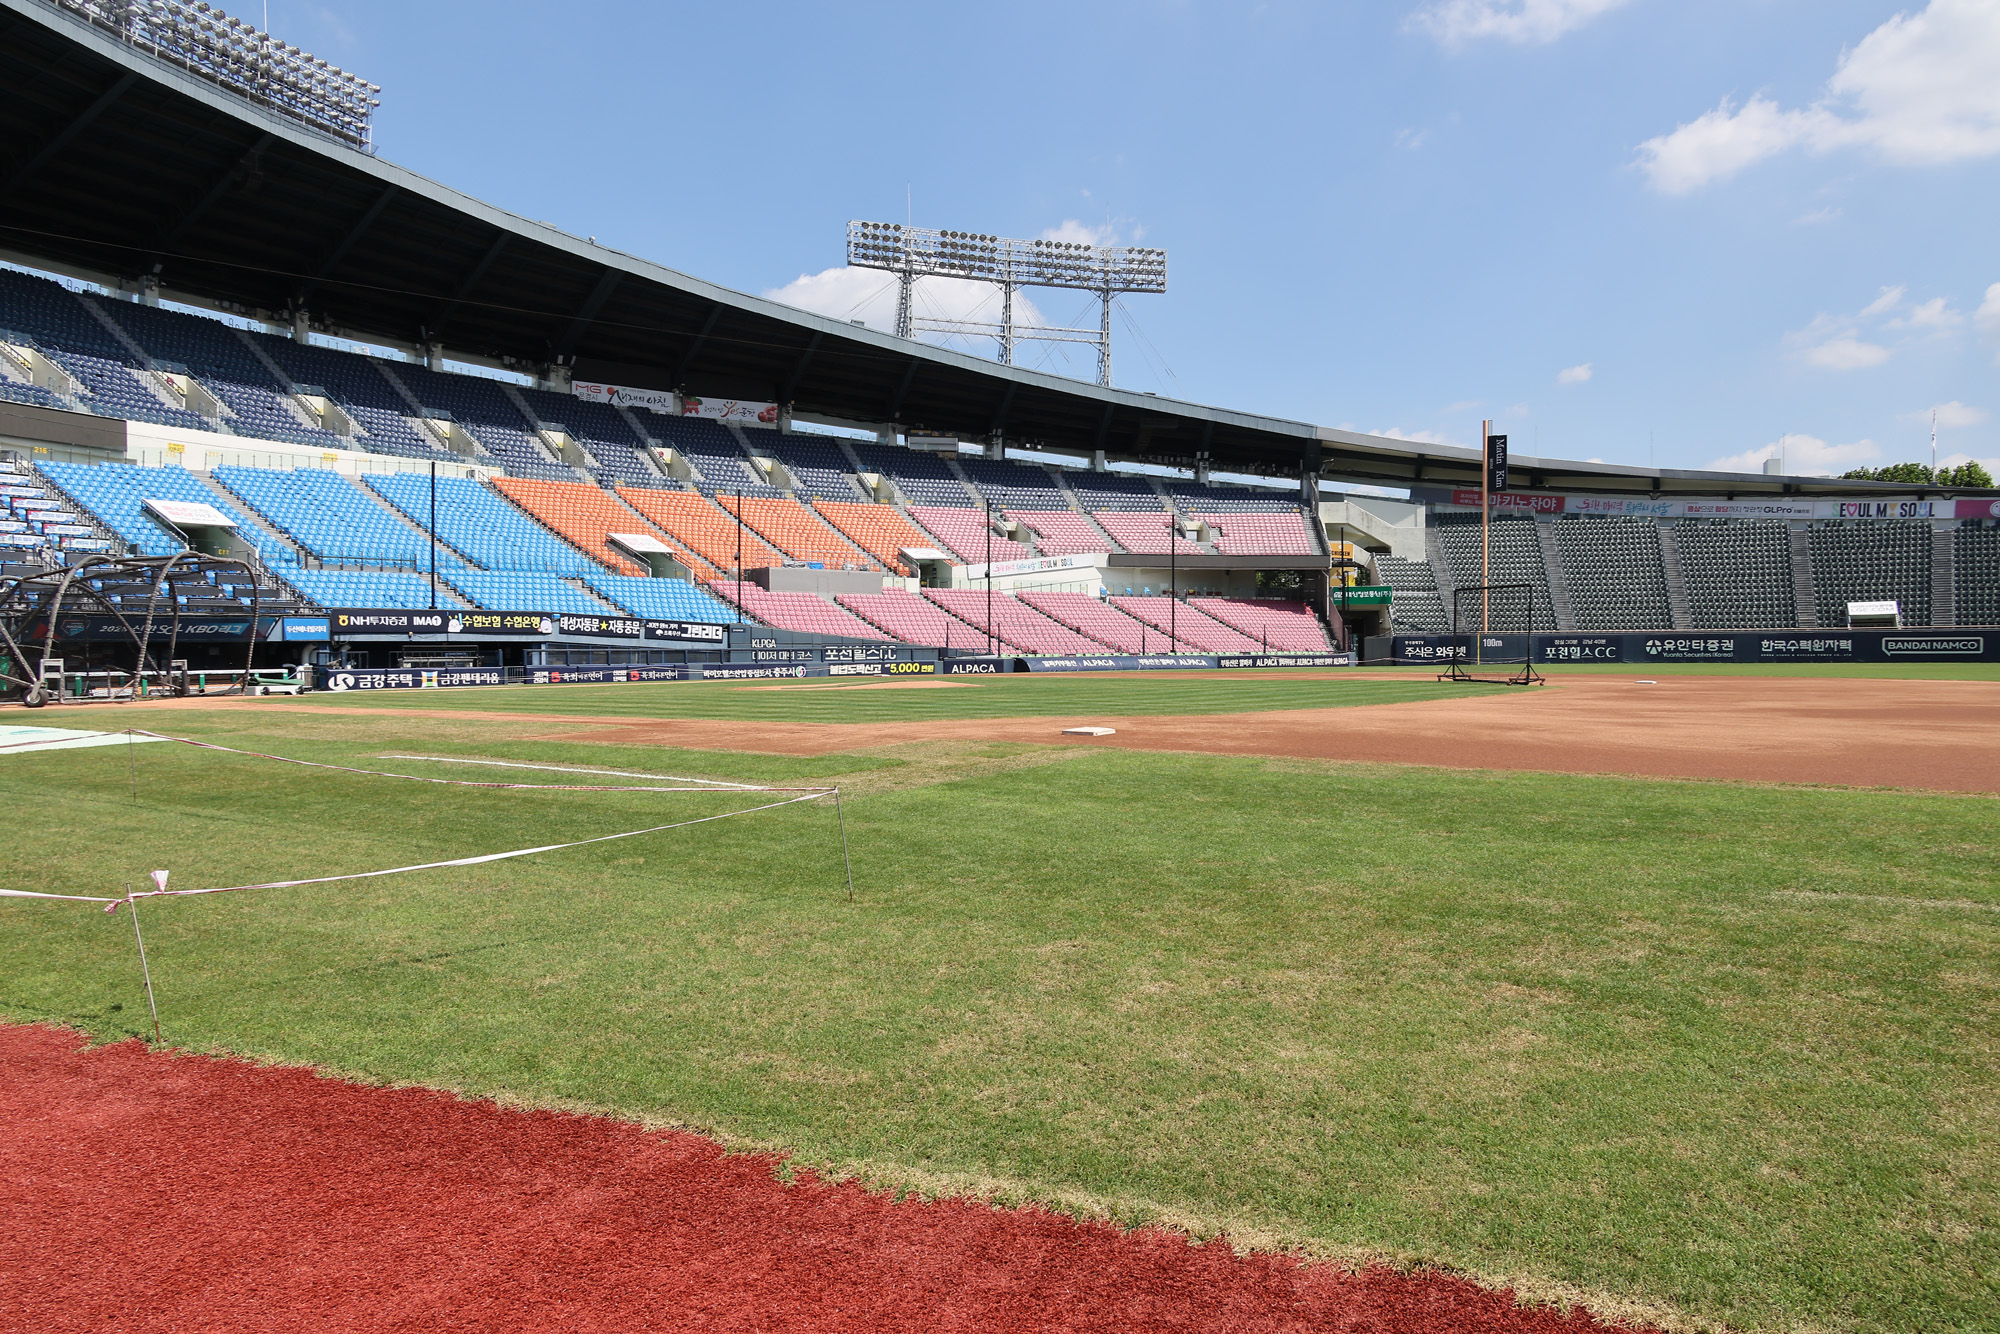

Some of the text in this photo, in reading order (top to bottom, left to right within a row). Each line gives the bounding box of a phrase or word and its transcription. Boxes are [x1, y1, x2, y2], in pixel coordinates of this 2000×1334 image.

[1495, 438, 1505, 489] Matin Kim
[1488, 493, 1557, 510] 마키노차야
[1650, 502, 1673, 516] 서울
[1763, 506, 1793, 514] GLPro
[350, 615, 408, 626] NH투자증권
[462, 615, 541, 629] 수협보험 수협은행
[559, 616, 640, 635] 태성자동문 자동중문
[286, 625, 327, 633] 두산에너빌리티
[681, 623, 723, 640] 그린리더
[751, 638, 777, 649] KLPGA
[1482, 638, 1503, 648] 100m
[1662, 639, 1734, 652] 유안타증권
[1760, 639, 1852, 652] 한국수력원자력
[1887, 641, 1978, 650] BANDAI NAMCO
[797, 651, 813, 660] 코스
[1404, 646, 1434, 658] 주식은
[1544, 646, 1616, 659] 포천힐스CC
[889, 662, 920, 674] 5,000
[1082, 659, 1116, 668] ALPACA
[1178, 658, 1208, 666] ALPACA
[1255, 658, 1278, 667] ALPACA
[773, 666, 796, 678] 충주시
[951, 663, 996, 674] ALPACA
[358, 672, 500, 689] 금강주택 금강펜테리움
